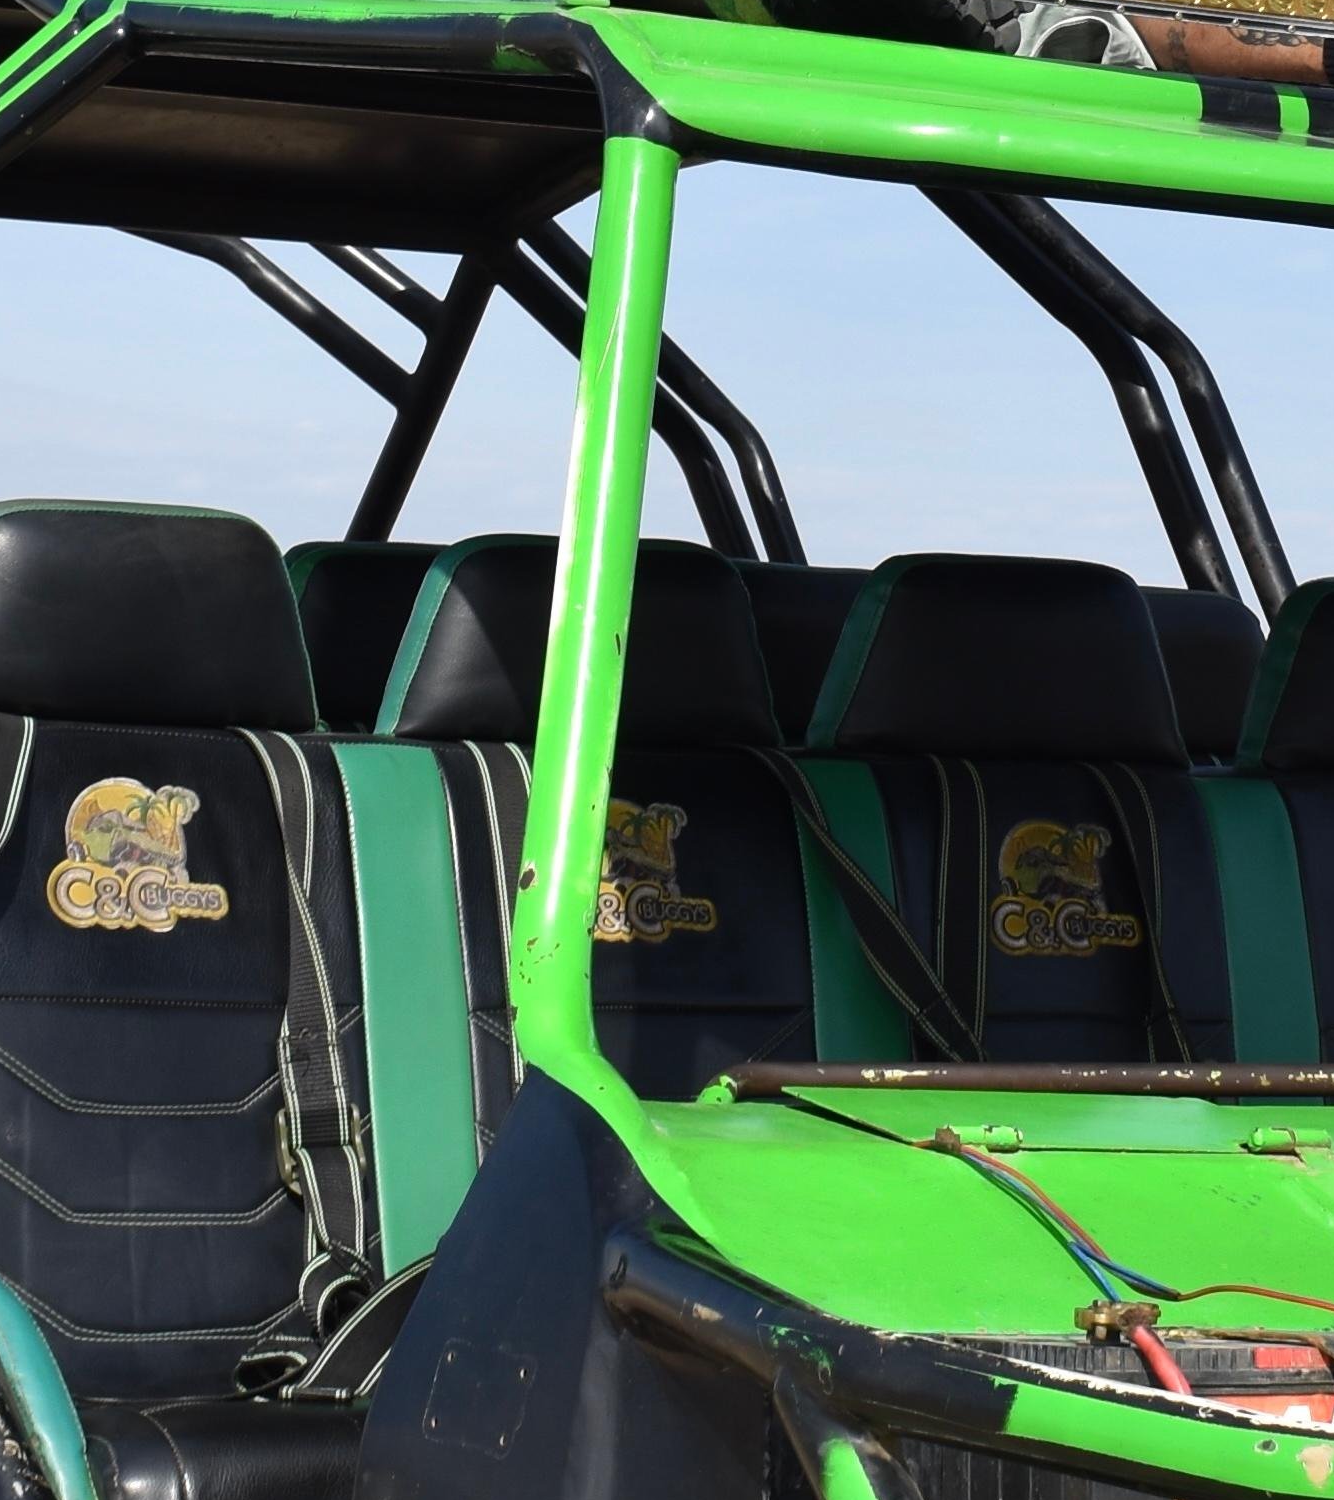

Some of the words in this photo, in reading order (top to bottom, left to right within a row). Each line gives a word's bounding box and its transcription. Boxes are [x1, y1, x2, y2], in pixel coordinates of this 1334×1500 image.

[56, 866, 171, 922] C&C
[144, 885, 221, 910] BUGGYS
[642, 902, 710, 922] BUGGYS
[992, 901, 1092, 951] C&C
